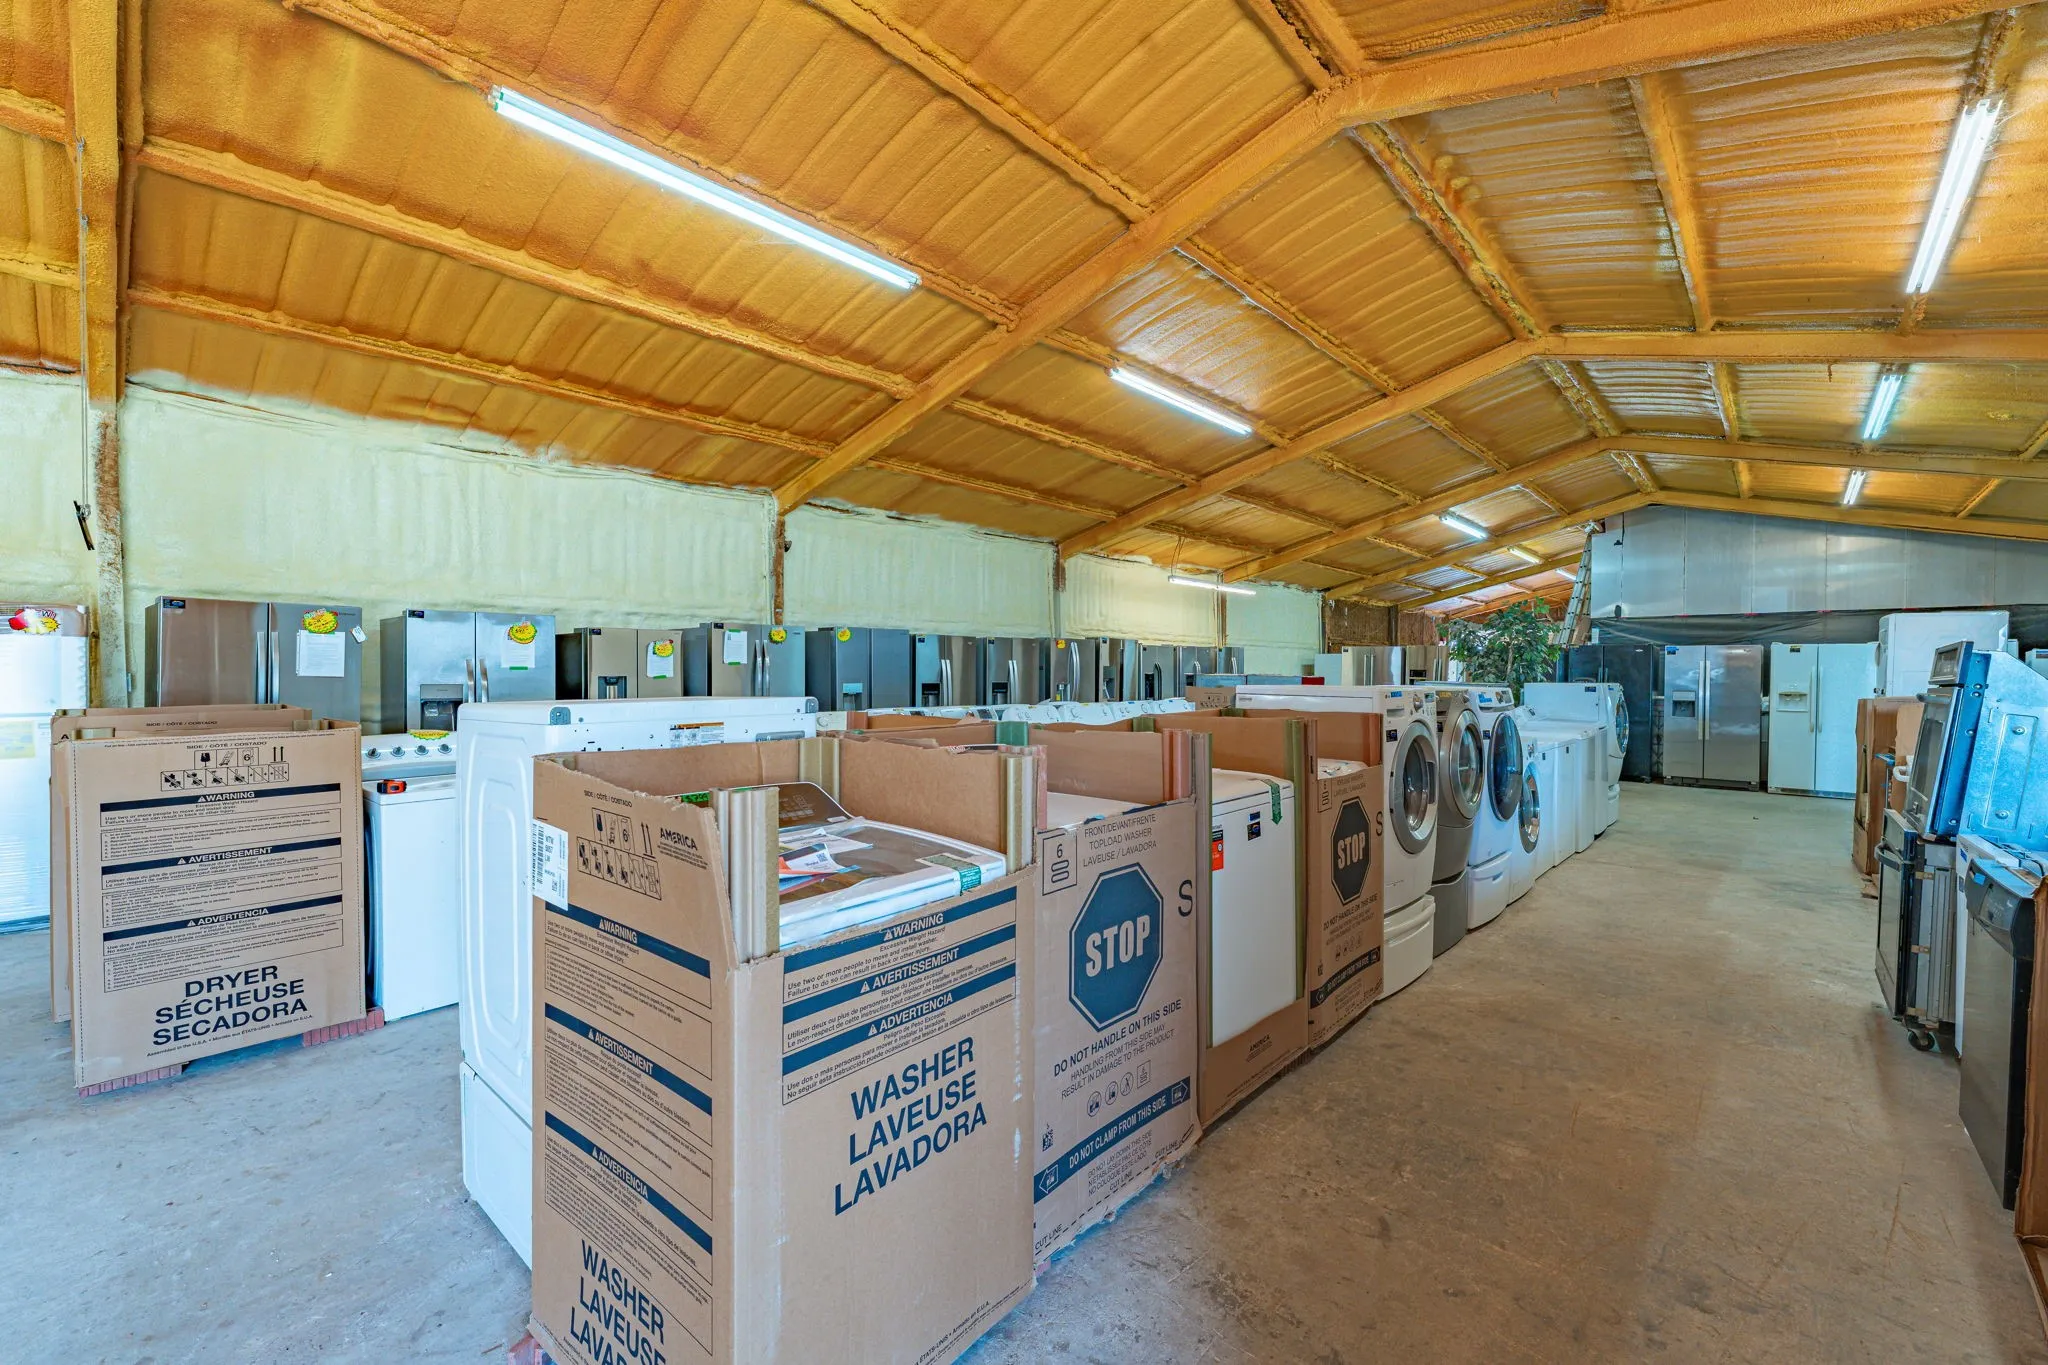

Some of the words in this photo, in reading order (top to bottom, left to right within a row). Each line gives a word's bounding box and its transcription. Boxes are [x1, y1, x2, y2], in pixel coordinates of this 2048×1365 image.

[206, 791, 255, 803] WARNING
[1084, 813, 1156, 838] FRONT/DEVANT/FRENTE
[1089, 832, 1123, 850] TOPLOAD
[1124, 828, 1152, 842] WASHER
[188, 847, 273, 864] AVERTISSEMENT
[1056, 843, 1063, 858] 6
[1083, 850, 1116, 867] LAVEUSE
[1121, 841, 1157, 857] LAVADORA
[1338, 832, 1365, 869] STOP
[197, 908, 269, 926] ADVERTENCIA
[604, 919, 638, 944] WARNING
[880, 939, 907, 951] Excessive
[908, 931, 926, 942] Weight
[927, 925, 945, 936] Hazard
[893, 913, 944, 938] WARNING
[787, 981, 801, 990] Use
[802, 976, 815, 985] two
[825, 967, 841, 977] more
[843, 960, 863, 972] people
[872, 952, 888, 962] move
[889, 947, 900, 956] and
[900, 941, 917, 952] install
[917, 937, 936, 947] washer.
[1086, 914, 1151, 978] STOP
[185, 965, 278, 997] DRYER
[787, 986, 810, 998] Failure
[839, 972, 851, 980] can
[852, 965, 869, 976] result
[877, 958, 890, 967] back
[900, 951, 914, 960] other
[873, 948, 959, 989] AVERTISSEMENT
[881, 985, 900, 996] Risque
[908, 977, 922, 987] poids
[923, 968, 943, 981] excessif
[153, 998, 308, 1046] SECADORA
[155, 979, 305, 1024] SÉCHEUSE
[787, 1027, 810, 1040] Utiliser
[811, 1020, 826, 1030] deux
[837, 1011, 849, 1021] plus
[859, 996, 888, 1012] personnes
[889, 991, 901, 1001] pour
[787, 1040, 795, 1048] Le
[796, 1023, 834, 1044] non-respect
[844, 1014, 859, 1025] cette
[860, 1002, 890, 1018] instruction
[890, 996, 903, 1007] peut
[880, 992, 953, 1032] ADVERTENCIA
[594, 1032, 654, 1075] AVERTISSEMENT
[883, 1028, 902, 1040] Peligro
[1054, 1059, 1067, 1077] DO
[1070, 1047, 1089, 1067] NOT
[1092, 1027, 1126, 1055] HANDLE
[1128, 1019, 1140, 1034] ON
[1142, 1010, 1160, 1026] THIS
[1163, 999, 1182, 1016] SIDE
[1071, 1056, 1104, 1081] HANDLING
[1105, 1045, 1123, 1061] FROM
[1125, 1037, 1138, 1051] THIS
[1139, 1030, 1152, 1043] SIDE
[1153, 1023, 1166, 1036] MAY
[787, 1081, 799, 1090] Use
[800, 1075, 813, 1084] dos
[833, 1054, 860, 1071] personas
[861, 1047, 875, 1058] para
[875, 1040, 892, 1051] mover
[787, 1090, 796, 1098] No
[797, 1081, 817, 1094] seguir
[818, 1074, 831, 1084] esta
[866, 1051, 883, 1063] puede
[884, 1038, 911, 1054] ocasionar
[851, 1037, 974, 1120] WASHER
[1061, 1077, 1086, 1100] RESULT
[1088, 1074, 1095, 1083] IN
[1095, 1057, 1122, 1078] DAMAGE
[1124, 1051, 1132, 1062] TO
[1133, 1045, 1145, 1057] THE
[1145, 1029, 1175, 1050] PRODUCT
[850, 1070, 976, 1165] LAVEUSE
[1069, 1155, 1078, 1169] DO
[1080, 1143, 1094, 1159] NOT
[1095, 1126, 1118, 1149] CLAMP
[1119, 1115, 1137, 1134] FROM
[1137, 1104, 1151, 1119] THIS
[1152, 1095, 1166, 1112] SIDE
[599, 1150, 649, 1198] ADVERTENCIA
[835, 1102, 987, 1216] LAVADORA
[1034, 1235, 1047, 1250] CUT
[1048, 1223, 1062, 1240] LINE
[581, 1239, 664, 1345] WASHER
